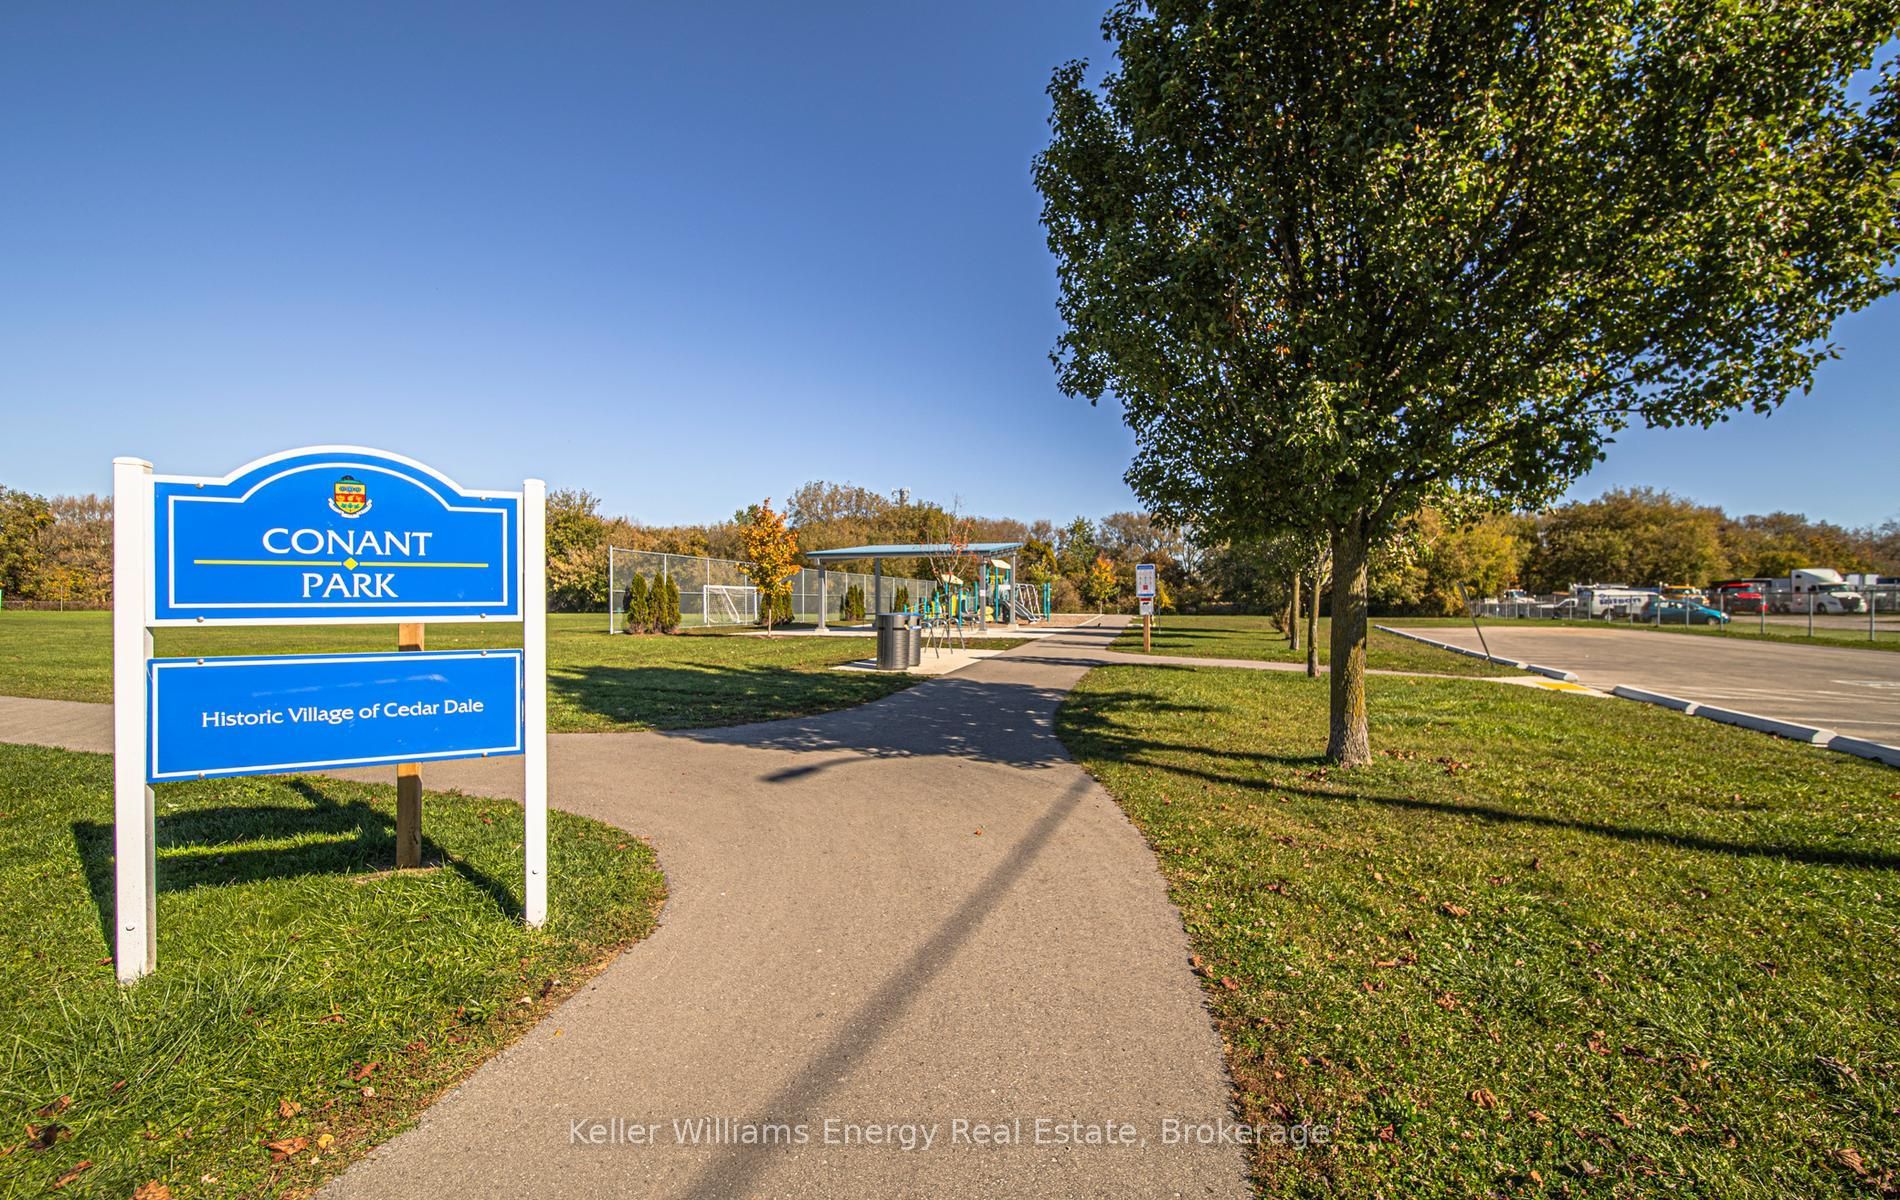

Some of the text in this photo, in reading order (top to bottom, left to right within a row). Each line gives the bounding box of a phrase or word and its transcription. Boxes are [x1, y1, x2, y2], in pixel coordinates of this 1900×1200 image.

[263, 528, 432, 556] CONANT
[302, 573, 399, 598] PARK
[202, 698, 484, 728] Historic Village of Cedar Dale
